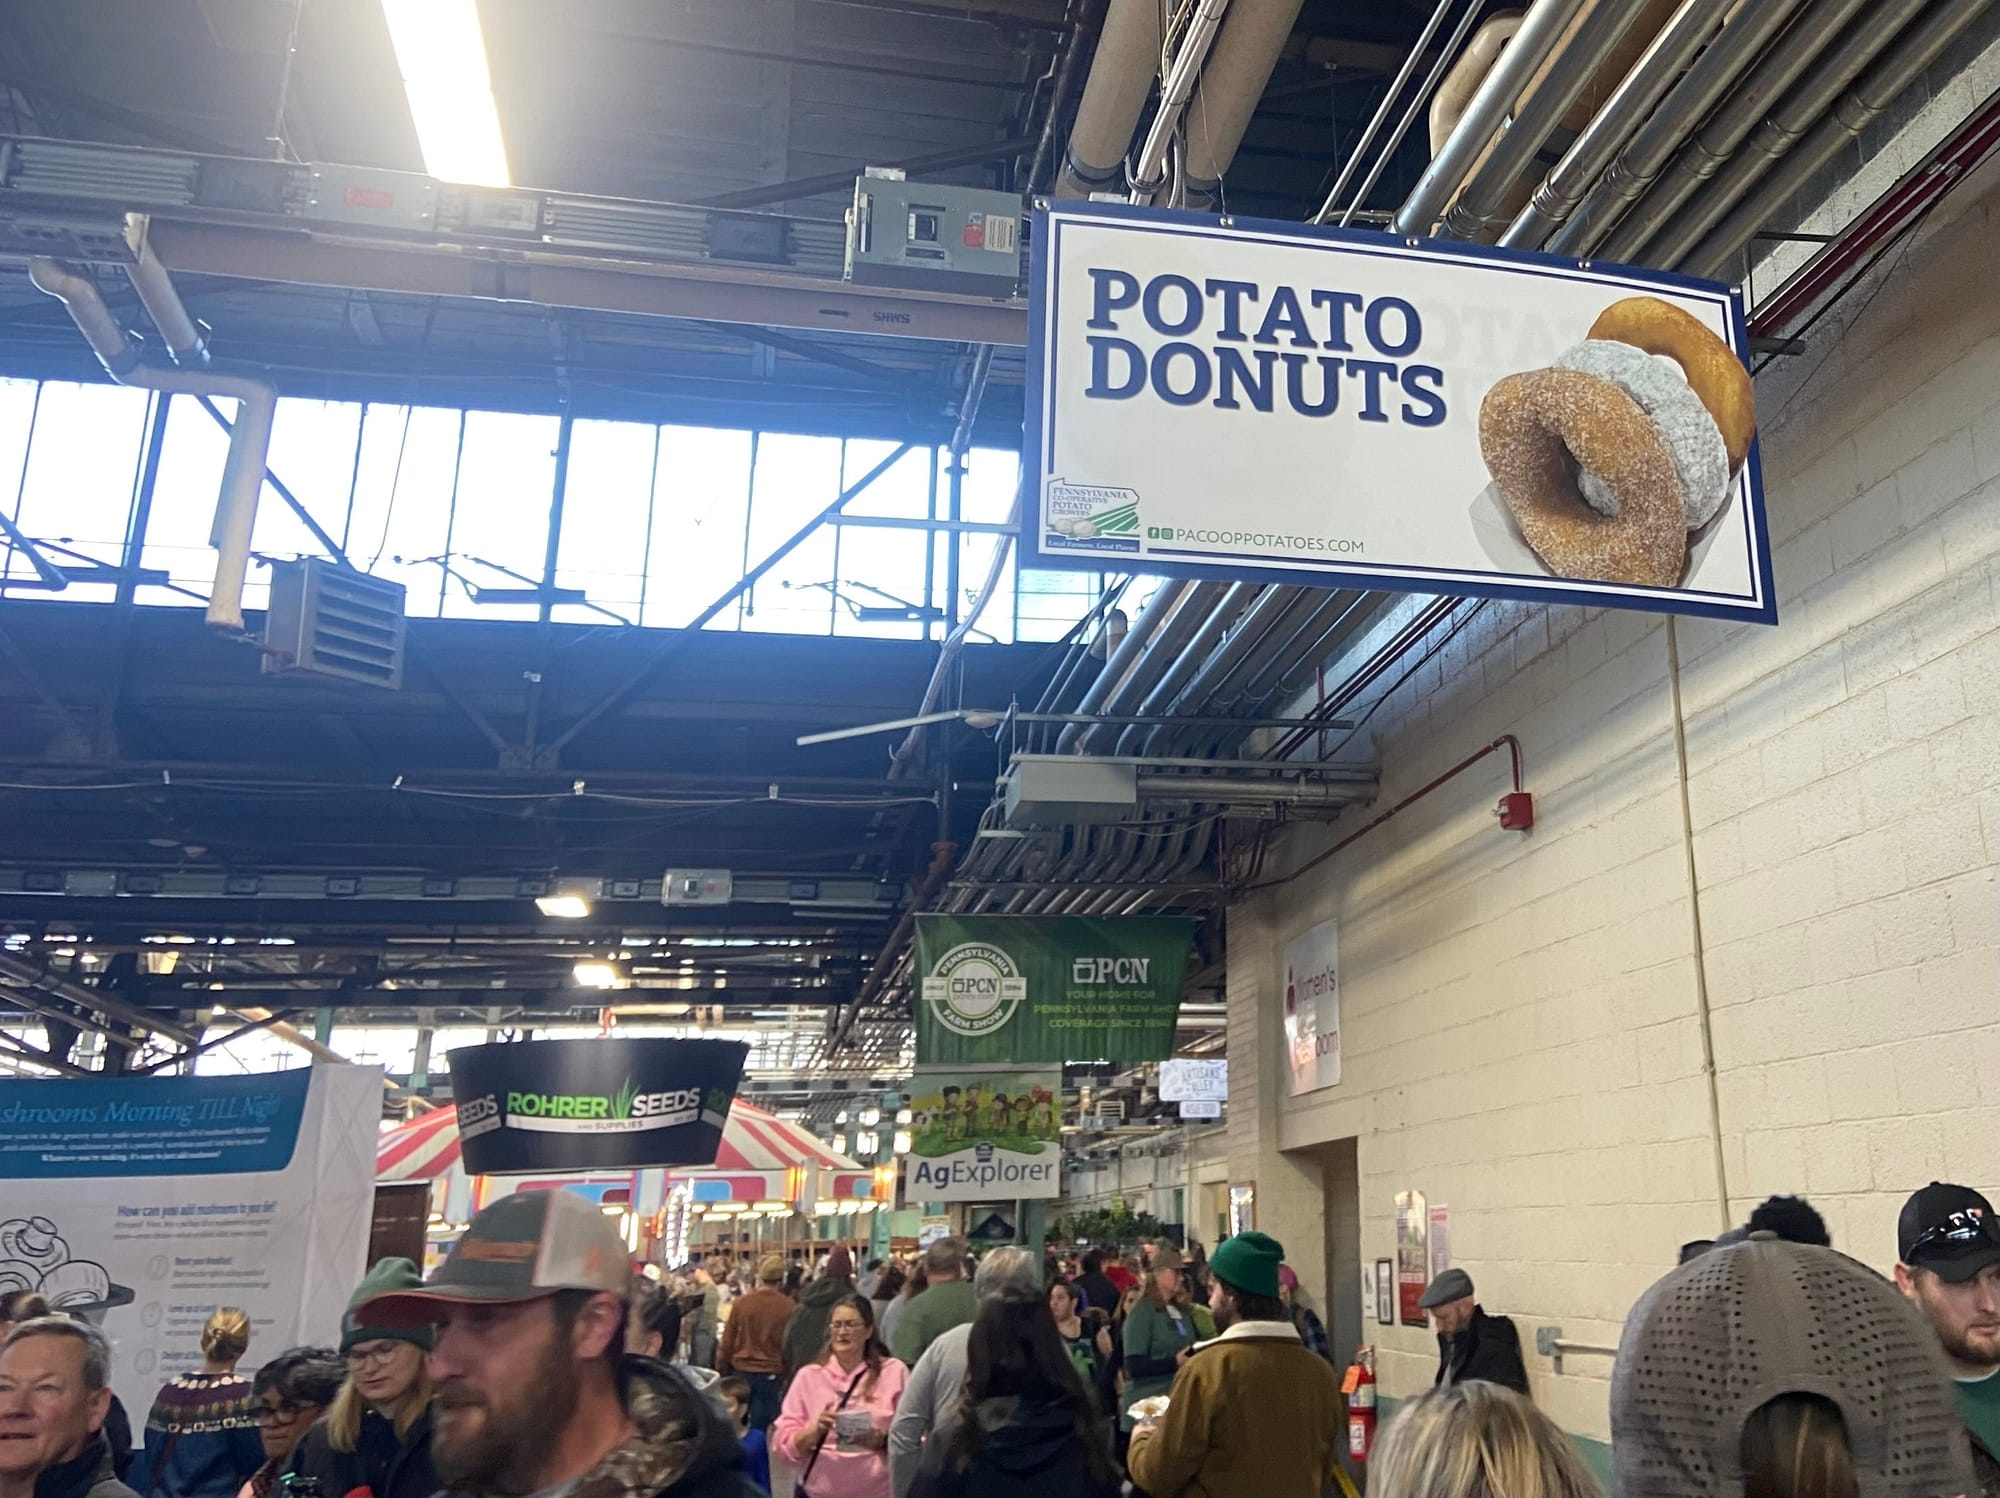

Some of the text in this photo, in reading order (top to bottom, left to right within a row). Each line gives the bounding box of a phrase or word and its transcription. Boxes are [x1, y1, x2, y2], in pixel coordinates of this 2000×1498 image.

[1087, 267, 1423, 357] POTATO
[1085, 335, 1447, 428] DONUTS
[1053, 487, 1129, 499] PENNSYLVANIA
[1053, 501, 1092, 511] POTATO
[1177, 528, 1365, 553] PACOOPPOTATOES.COM
[940, 948, 1010, 975] PENNSYLVANIA
[1096, 958, 1150, 984] PCN
[965, 978, 997, 993] PCN
[1065, 990, 1097, 1000] YOUR
[943, 1008, 1004, 1030] FARM SHOW
[1033, 1004, 1118, 1014] PENNSYLVANIA
[0, 1100, 97, 1123] shrooms
[104, 1097, 194, 1127] Morning
[198, 1097, 238, 1120] TILL
[507, 1091, 609, 1118] ROHRER
[632, 1087, 700, 1117] SEEDS
[595, 1121, 644, 1130] SUPPLIES
[914, 1158, 1054, 1190] AgExplorer
